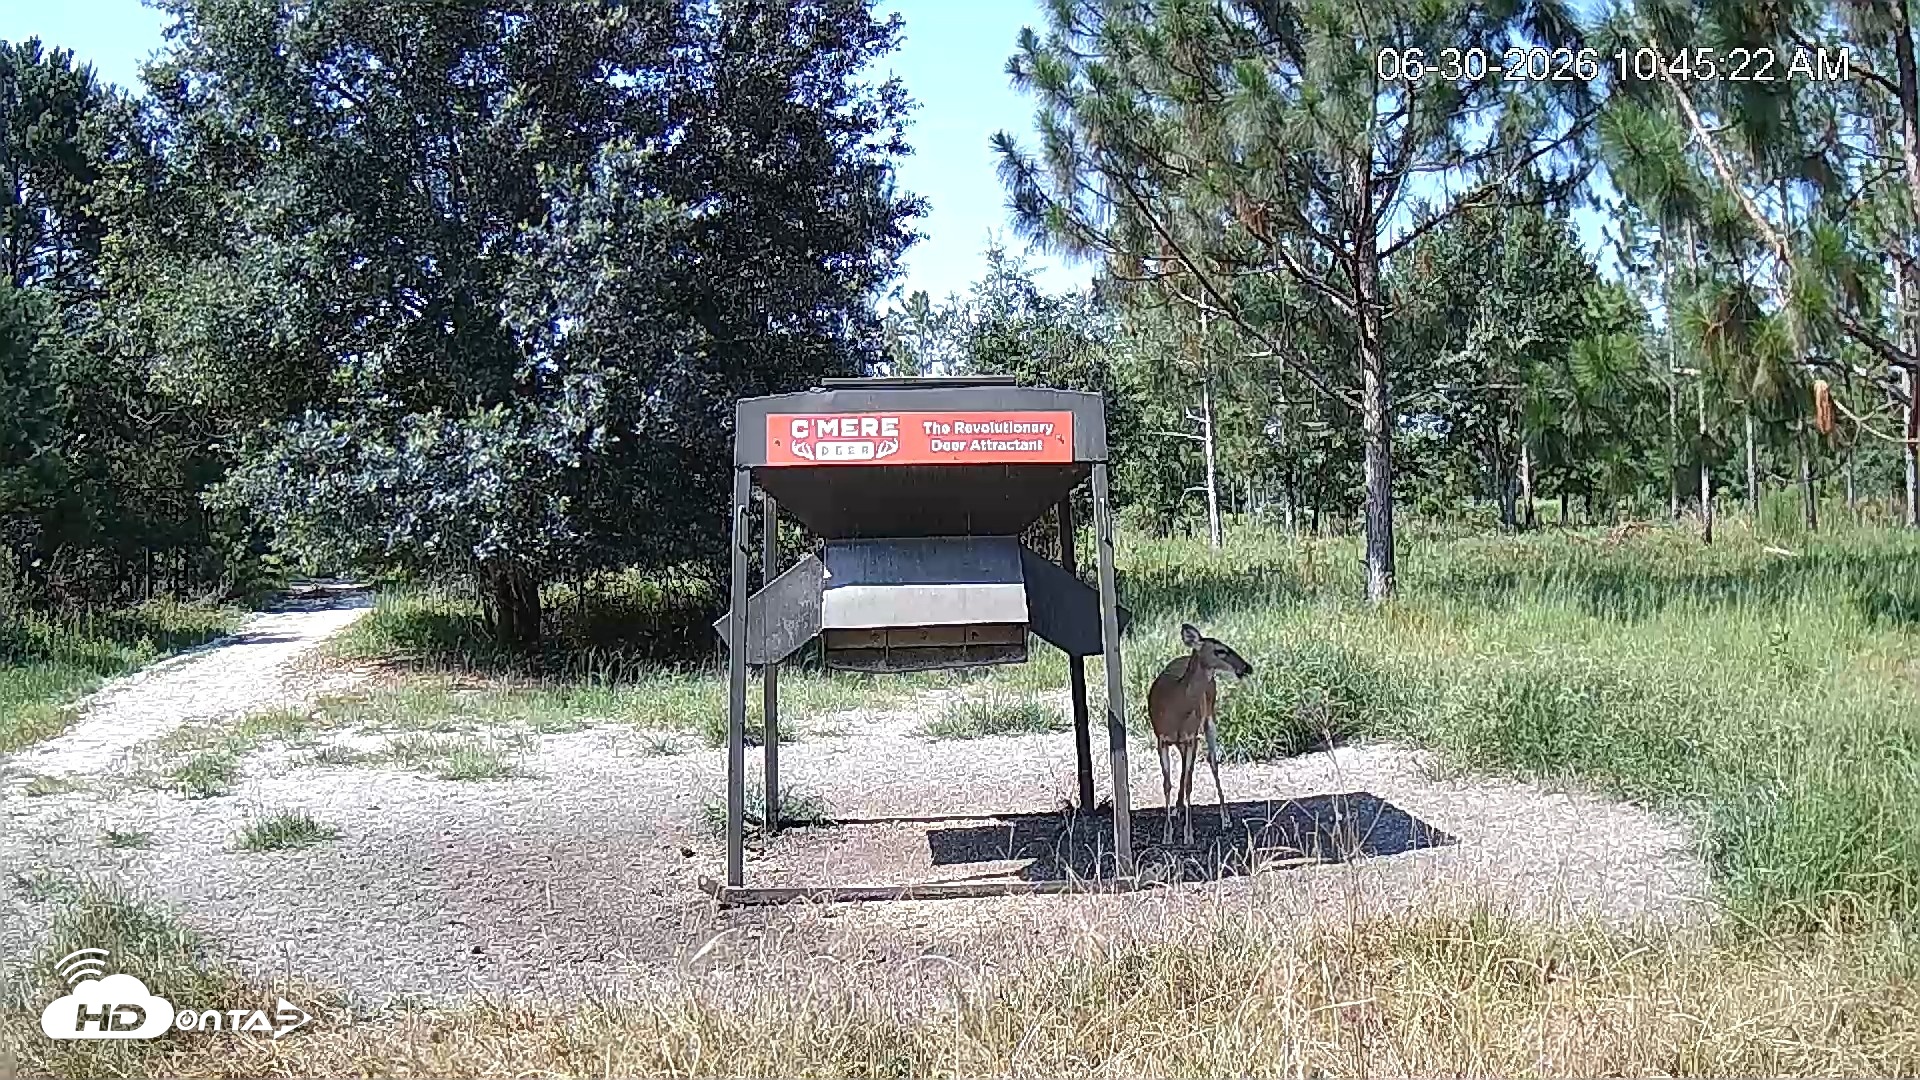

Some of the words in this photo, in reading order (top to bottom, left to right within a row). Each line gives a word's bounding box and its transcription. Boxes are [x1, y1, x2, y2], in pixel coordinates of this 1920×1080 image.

[790, 417, 899, 438] C'MERE
[923, 421, 951, 435] The
[954, 421, 1054, 436] Revolutionary
[930, 439, 966, 453] Deer
[970, 438, 1043, 453] Attractant
